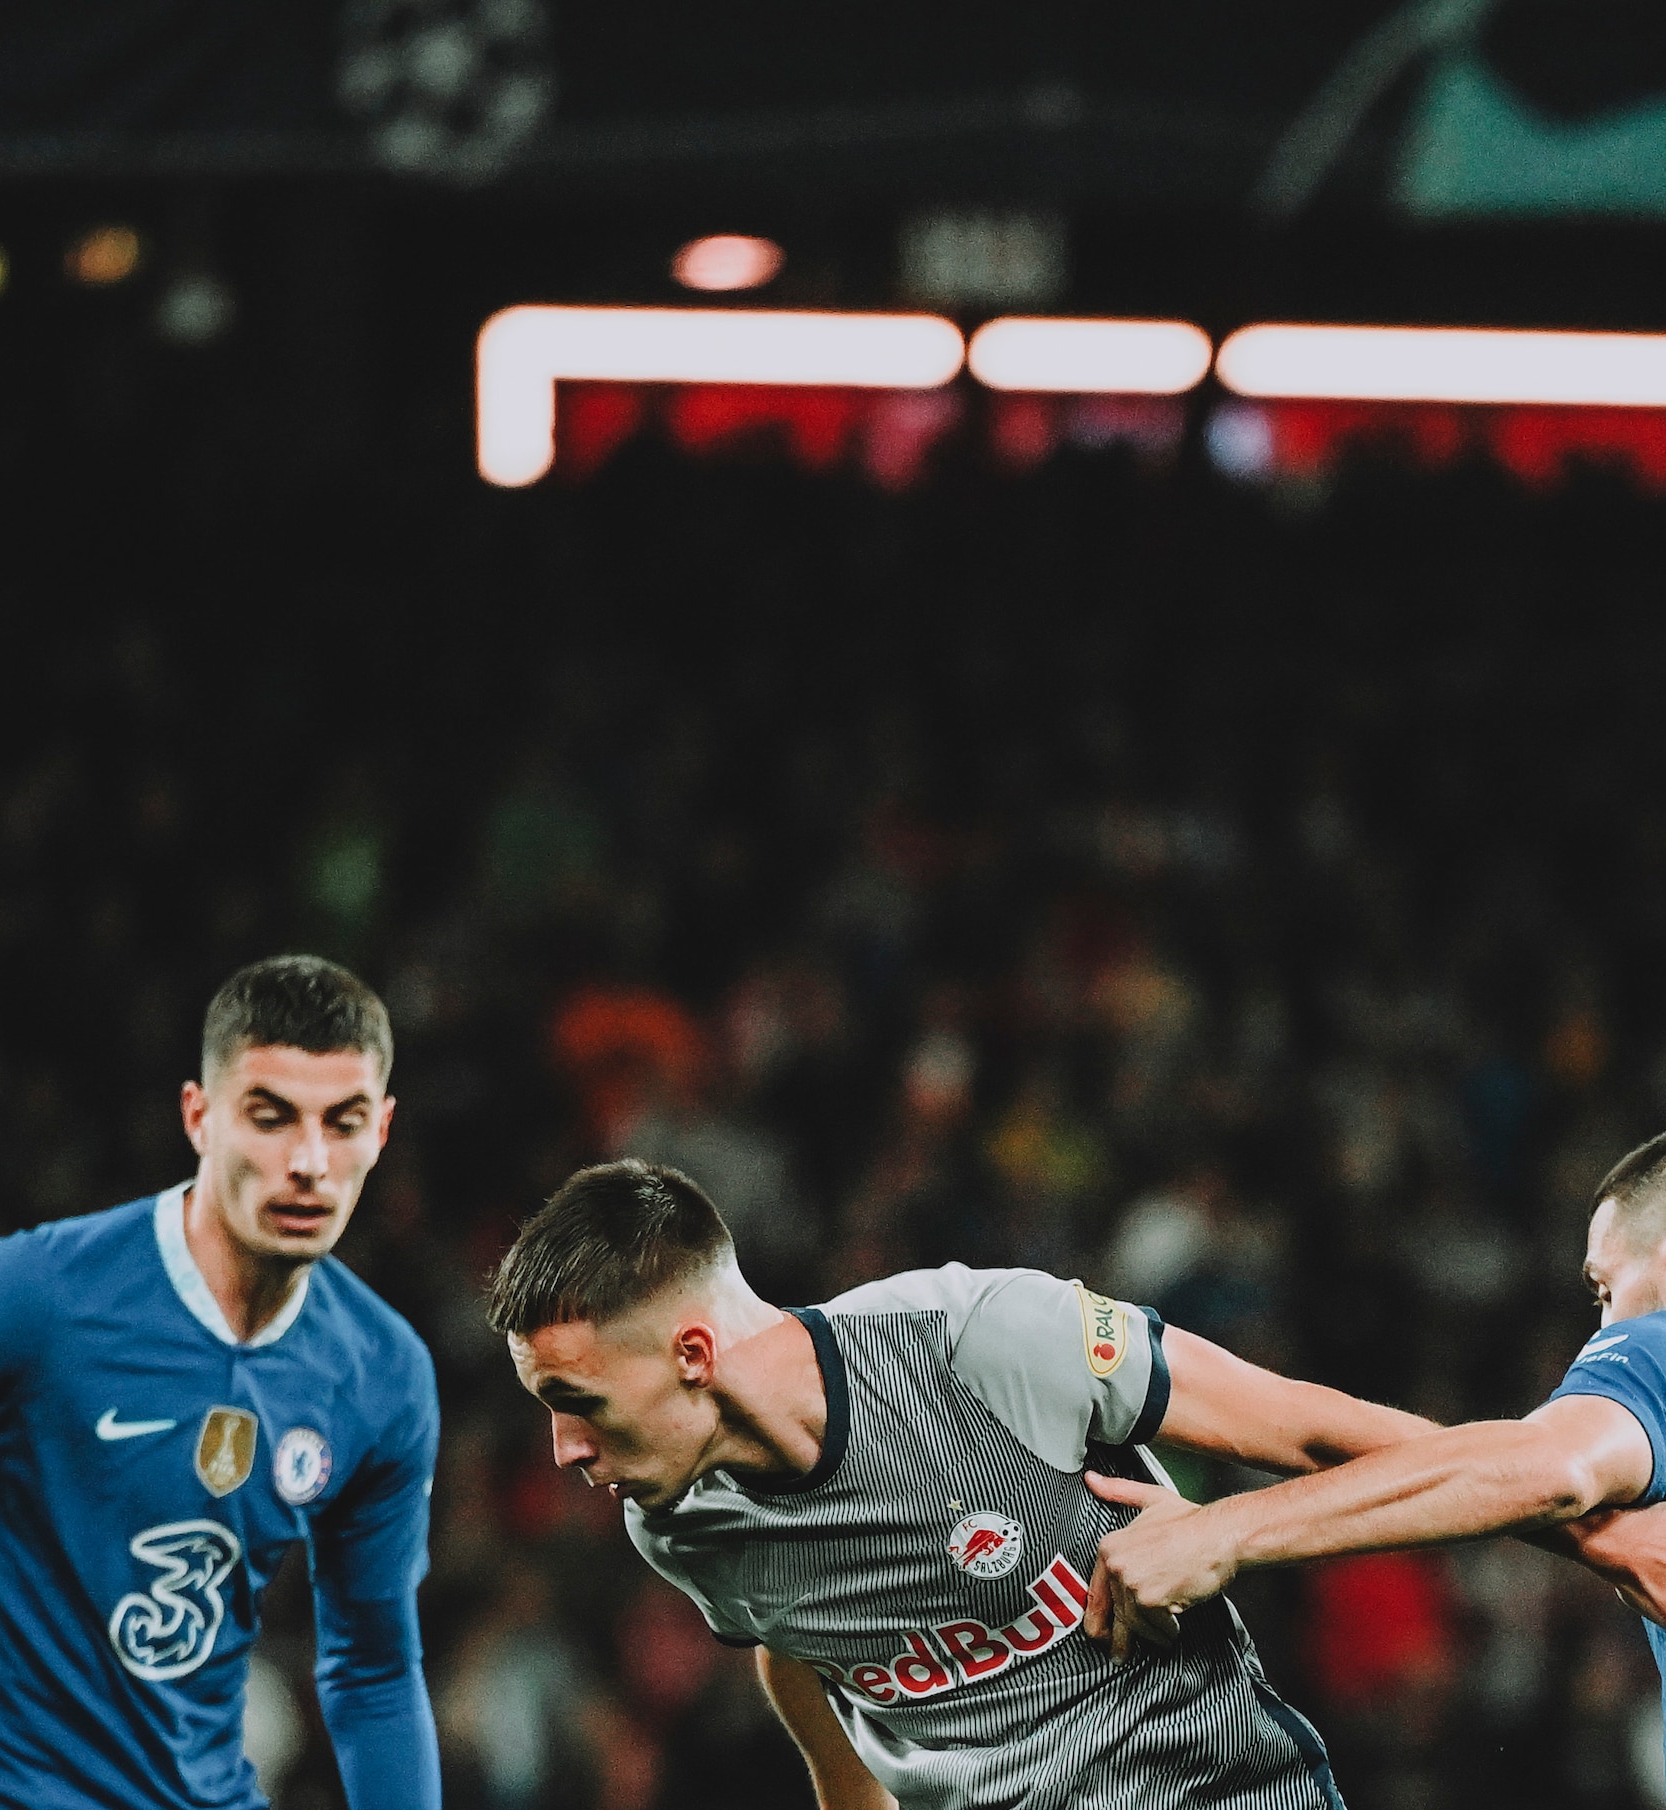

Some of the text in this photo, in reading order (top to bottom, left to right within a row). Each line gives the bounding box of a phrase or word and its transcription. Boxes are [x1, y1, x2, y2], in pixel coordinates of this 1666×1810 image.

[962, 1519, 978, 1532] FC
[973, 1546, 1017, 1574] SALZBURG
[936, 1559, 1089, 1678] Bull
